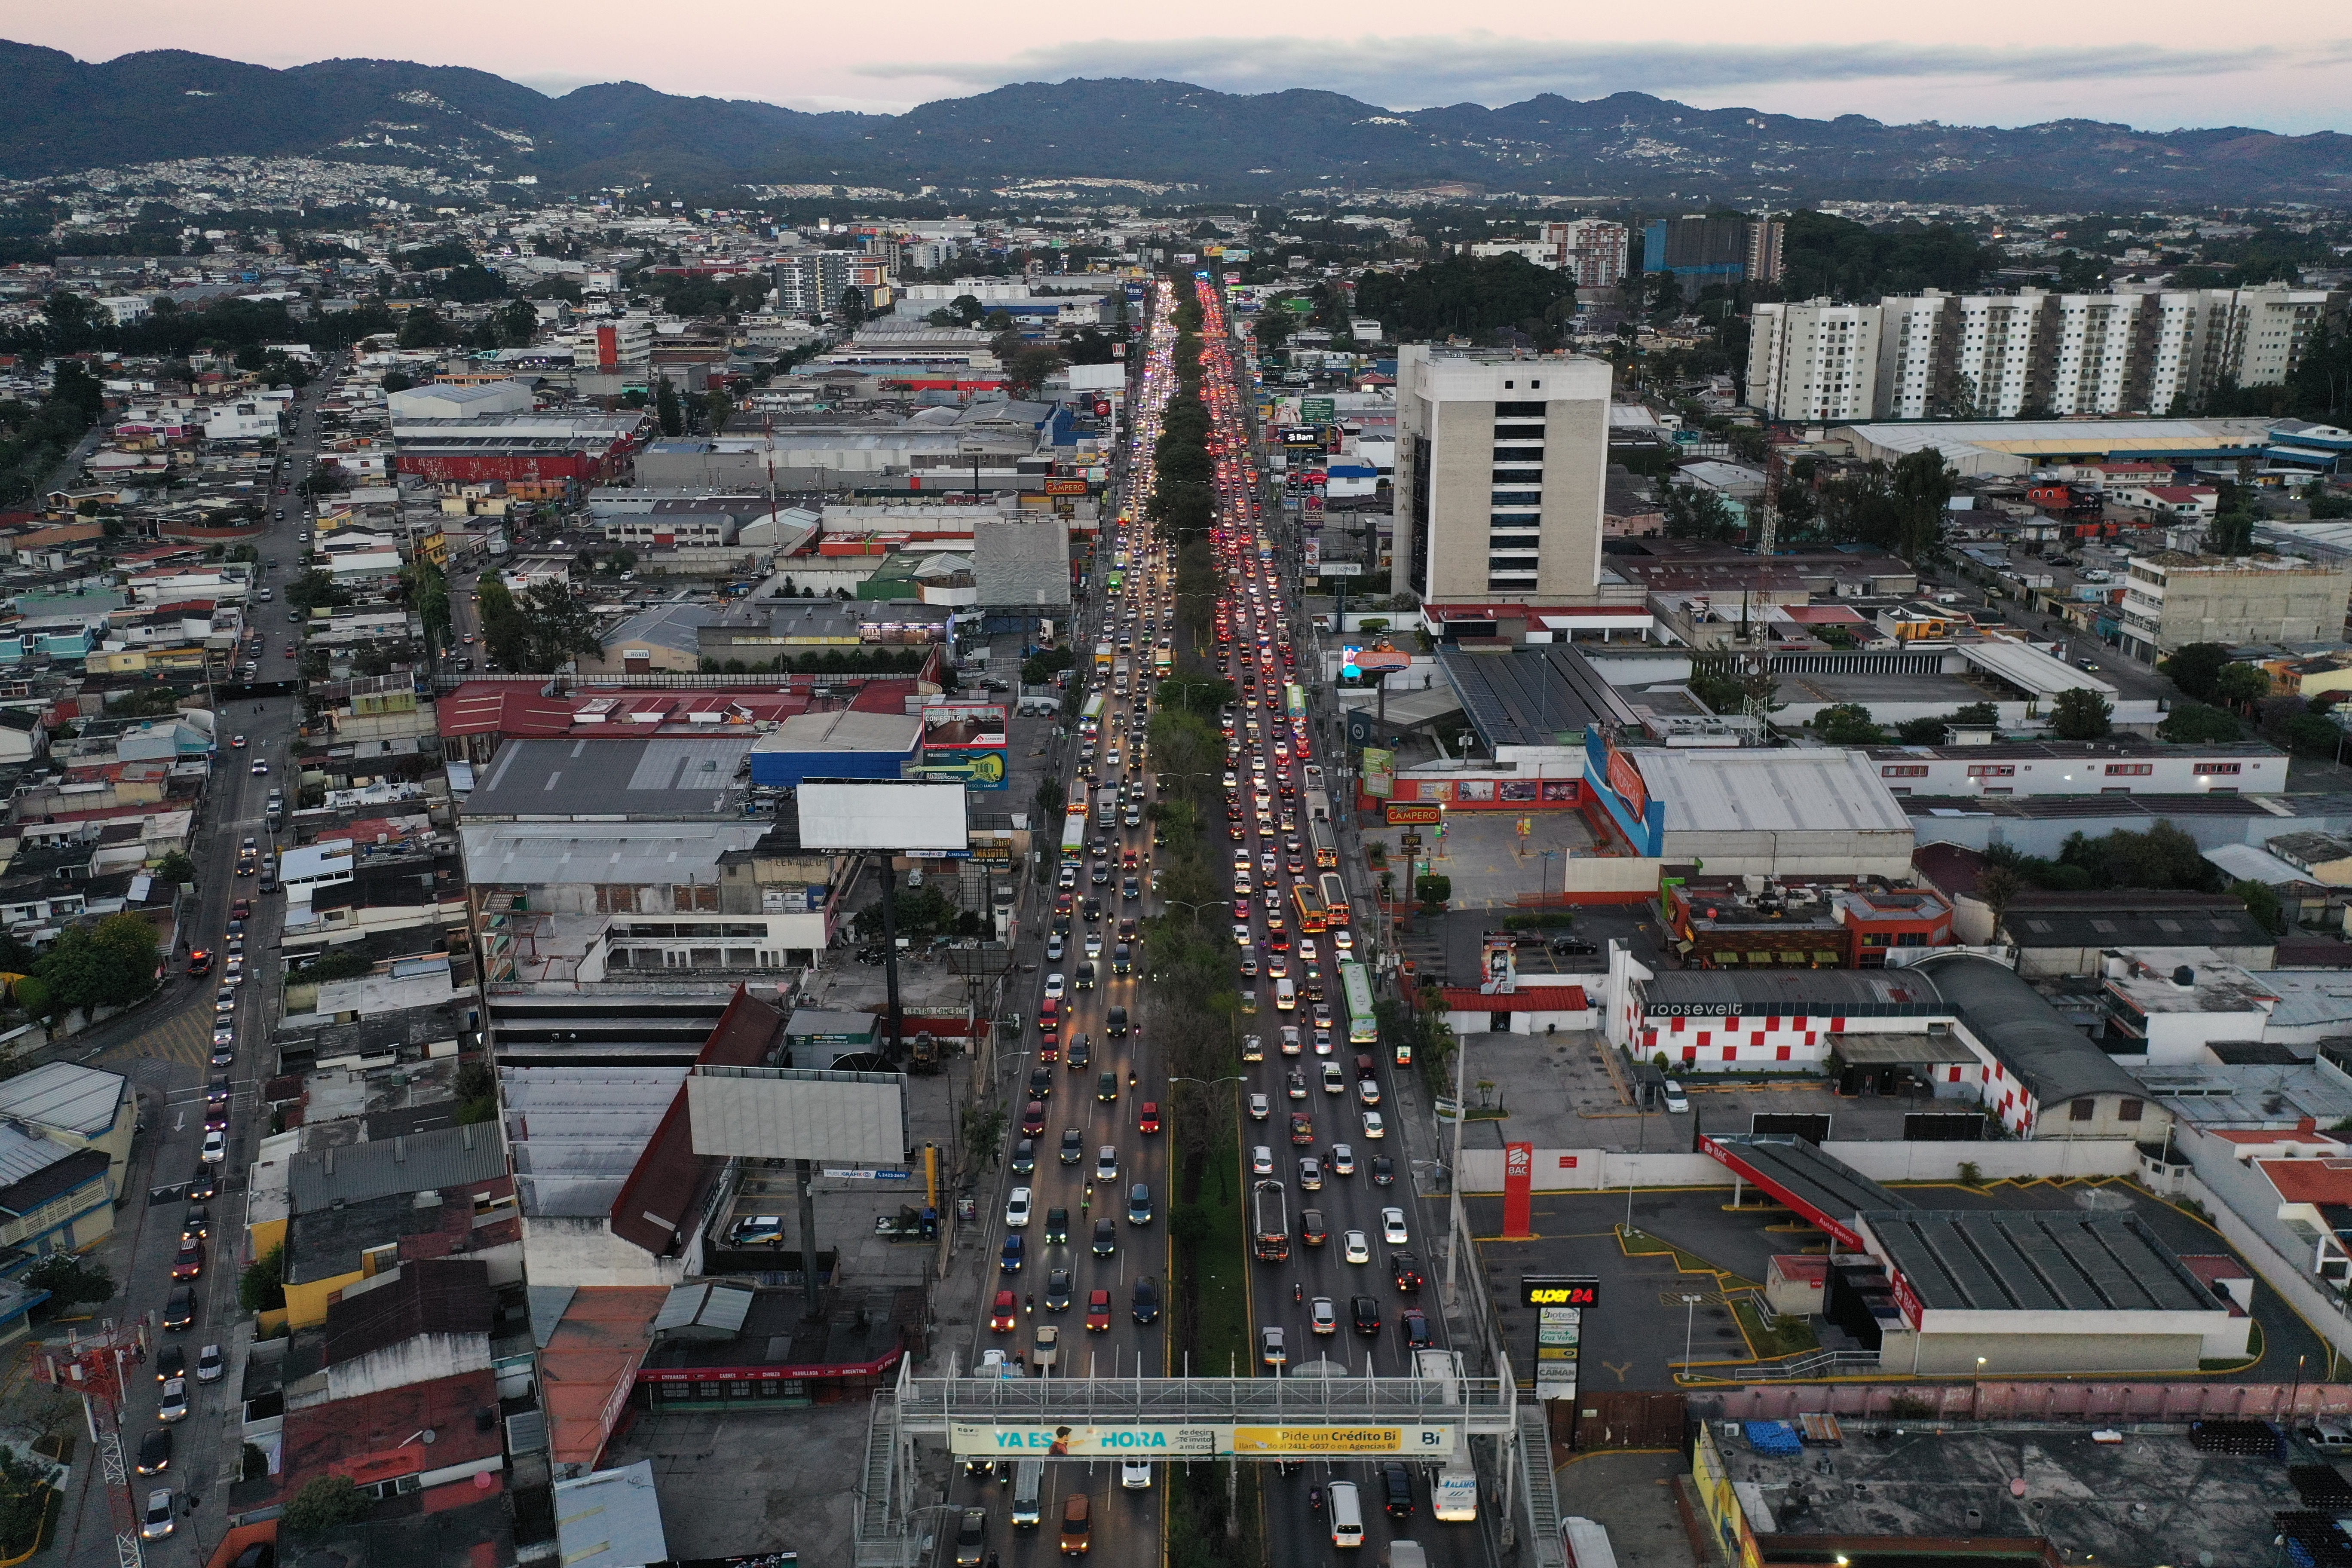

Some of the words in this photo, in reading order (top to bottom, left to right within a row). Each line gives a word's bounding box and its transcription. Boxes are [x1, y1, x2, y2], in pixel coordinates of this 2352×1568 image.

[1389, 812, 1437, 820] CAMPERO
[1651, 1002, 1743, 1015] roosevelt
[1714, 1147, 1727, 1163] BAC
[1508, 1166, 1528, 1174] BAC
[1819, 1217, 1834, 1232] Auto
[1834, 1227, 1854, 1244] Banco
[1530, 1289, 1571, 1304] super
[1571, 1289, 1593, 1303] 24
[613, 1374, 630, 1415] Hero
[995, 1432, 1024, 1448] YA
[1029, 1432, 1054, 1448] ES
[1101, 1432, 1167, 1447] HORA
[1282, 1431, 1309, 1441] Pide
[1332, 1431, 1381, 1441] Crédito
[1384, 1431, 1396, 1441] Bi
[1422, 1429, 1443, 1445] Bi
